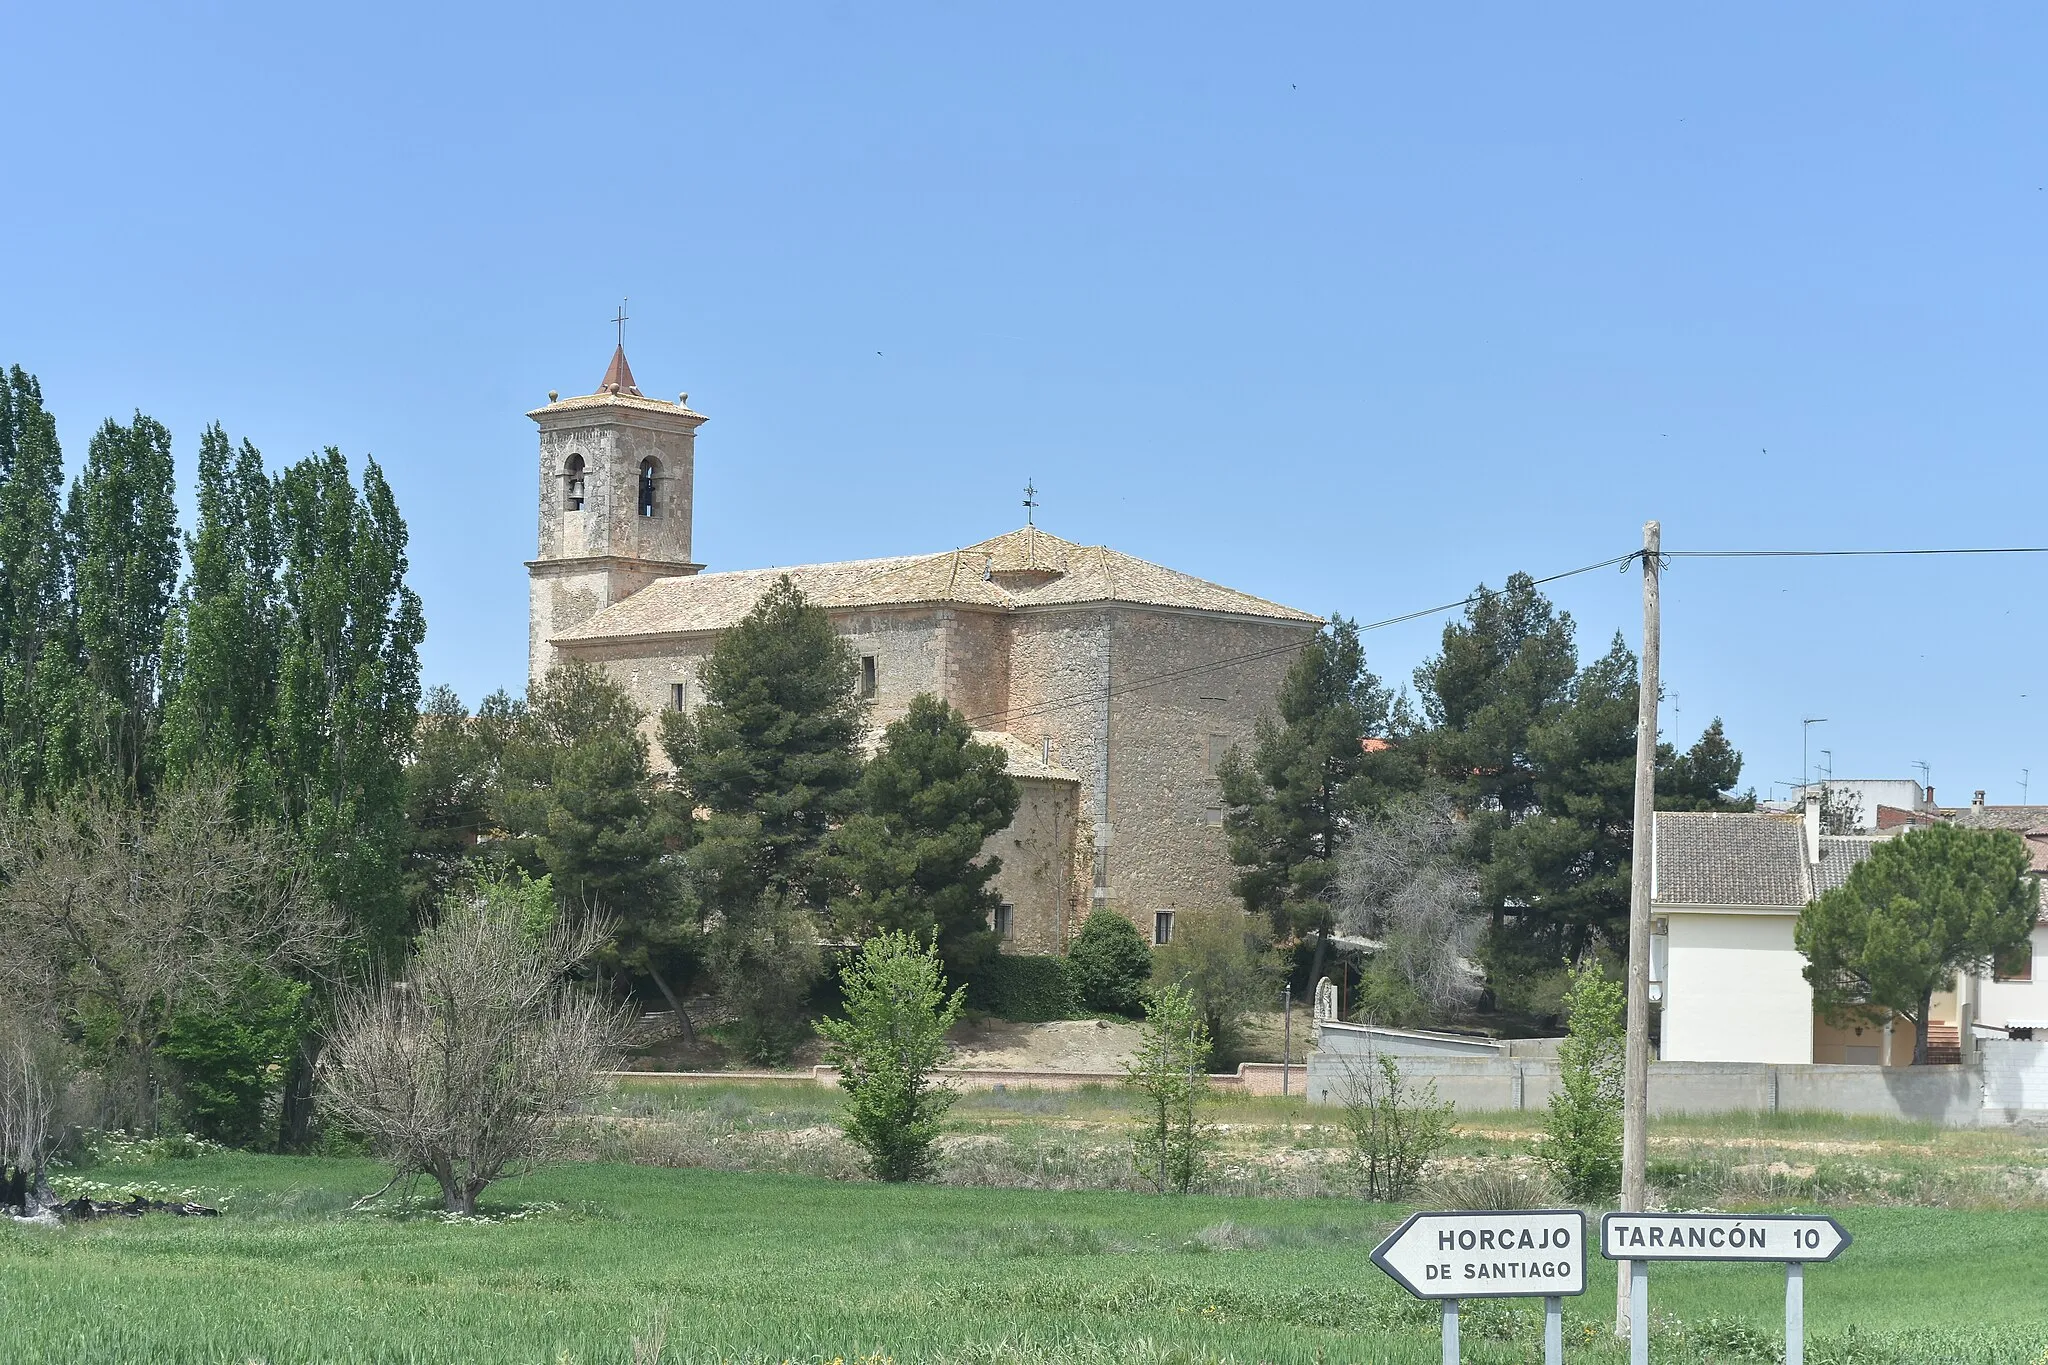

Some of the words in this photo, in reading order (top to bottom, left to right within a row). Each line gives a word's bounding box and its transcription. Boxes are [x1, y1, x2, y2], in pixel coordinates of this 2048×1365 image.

[1438, 1228, 1571, 1251] HORCAJO
[1614, 1222, 1767, 1248] TARANCÓN
[1793, 1228, 1820, 1249] 10
[1425, 1263, 1452, 1280] DE
[1464, 1262, 1571, 1280] SANTIAGO
